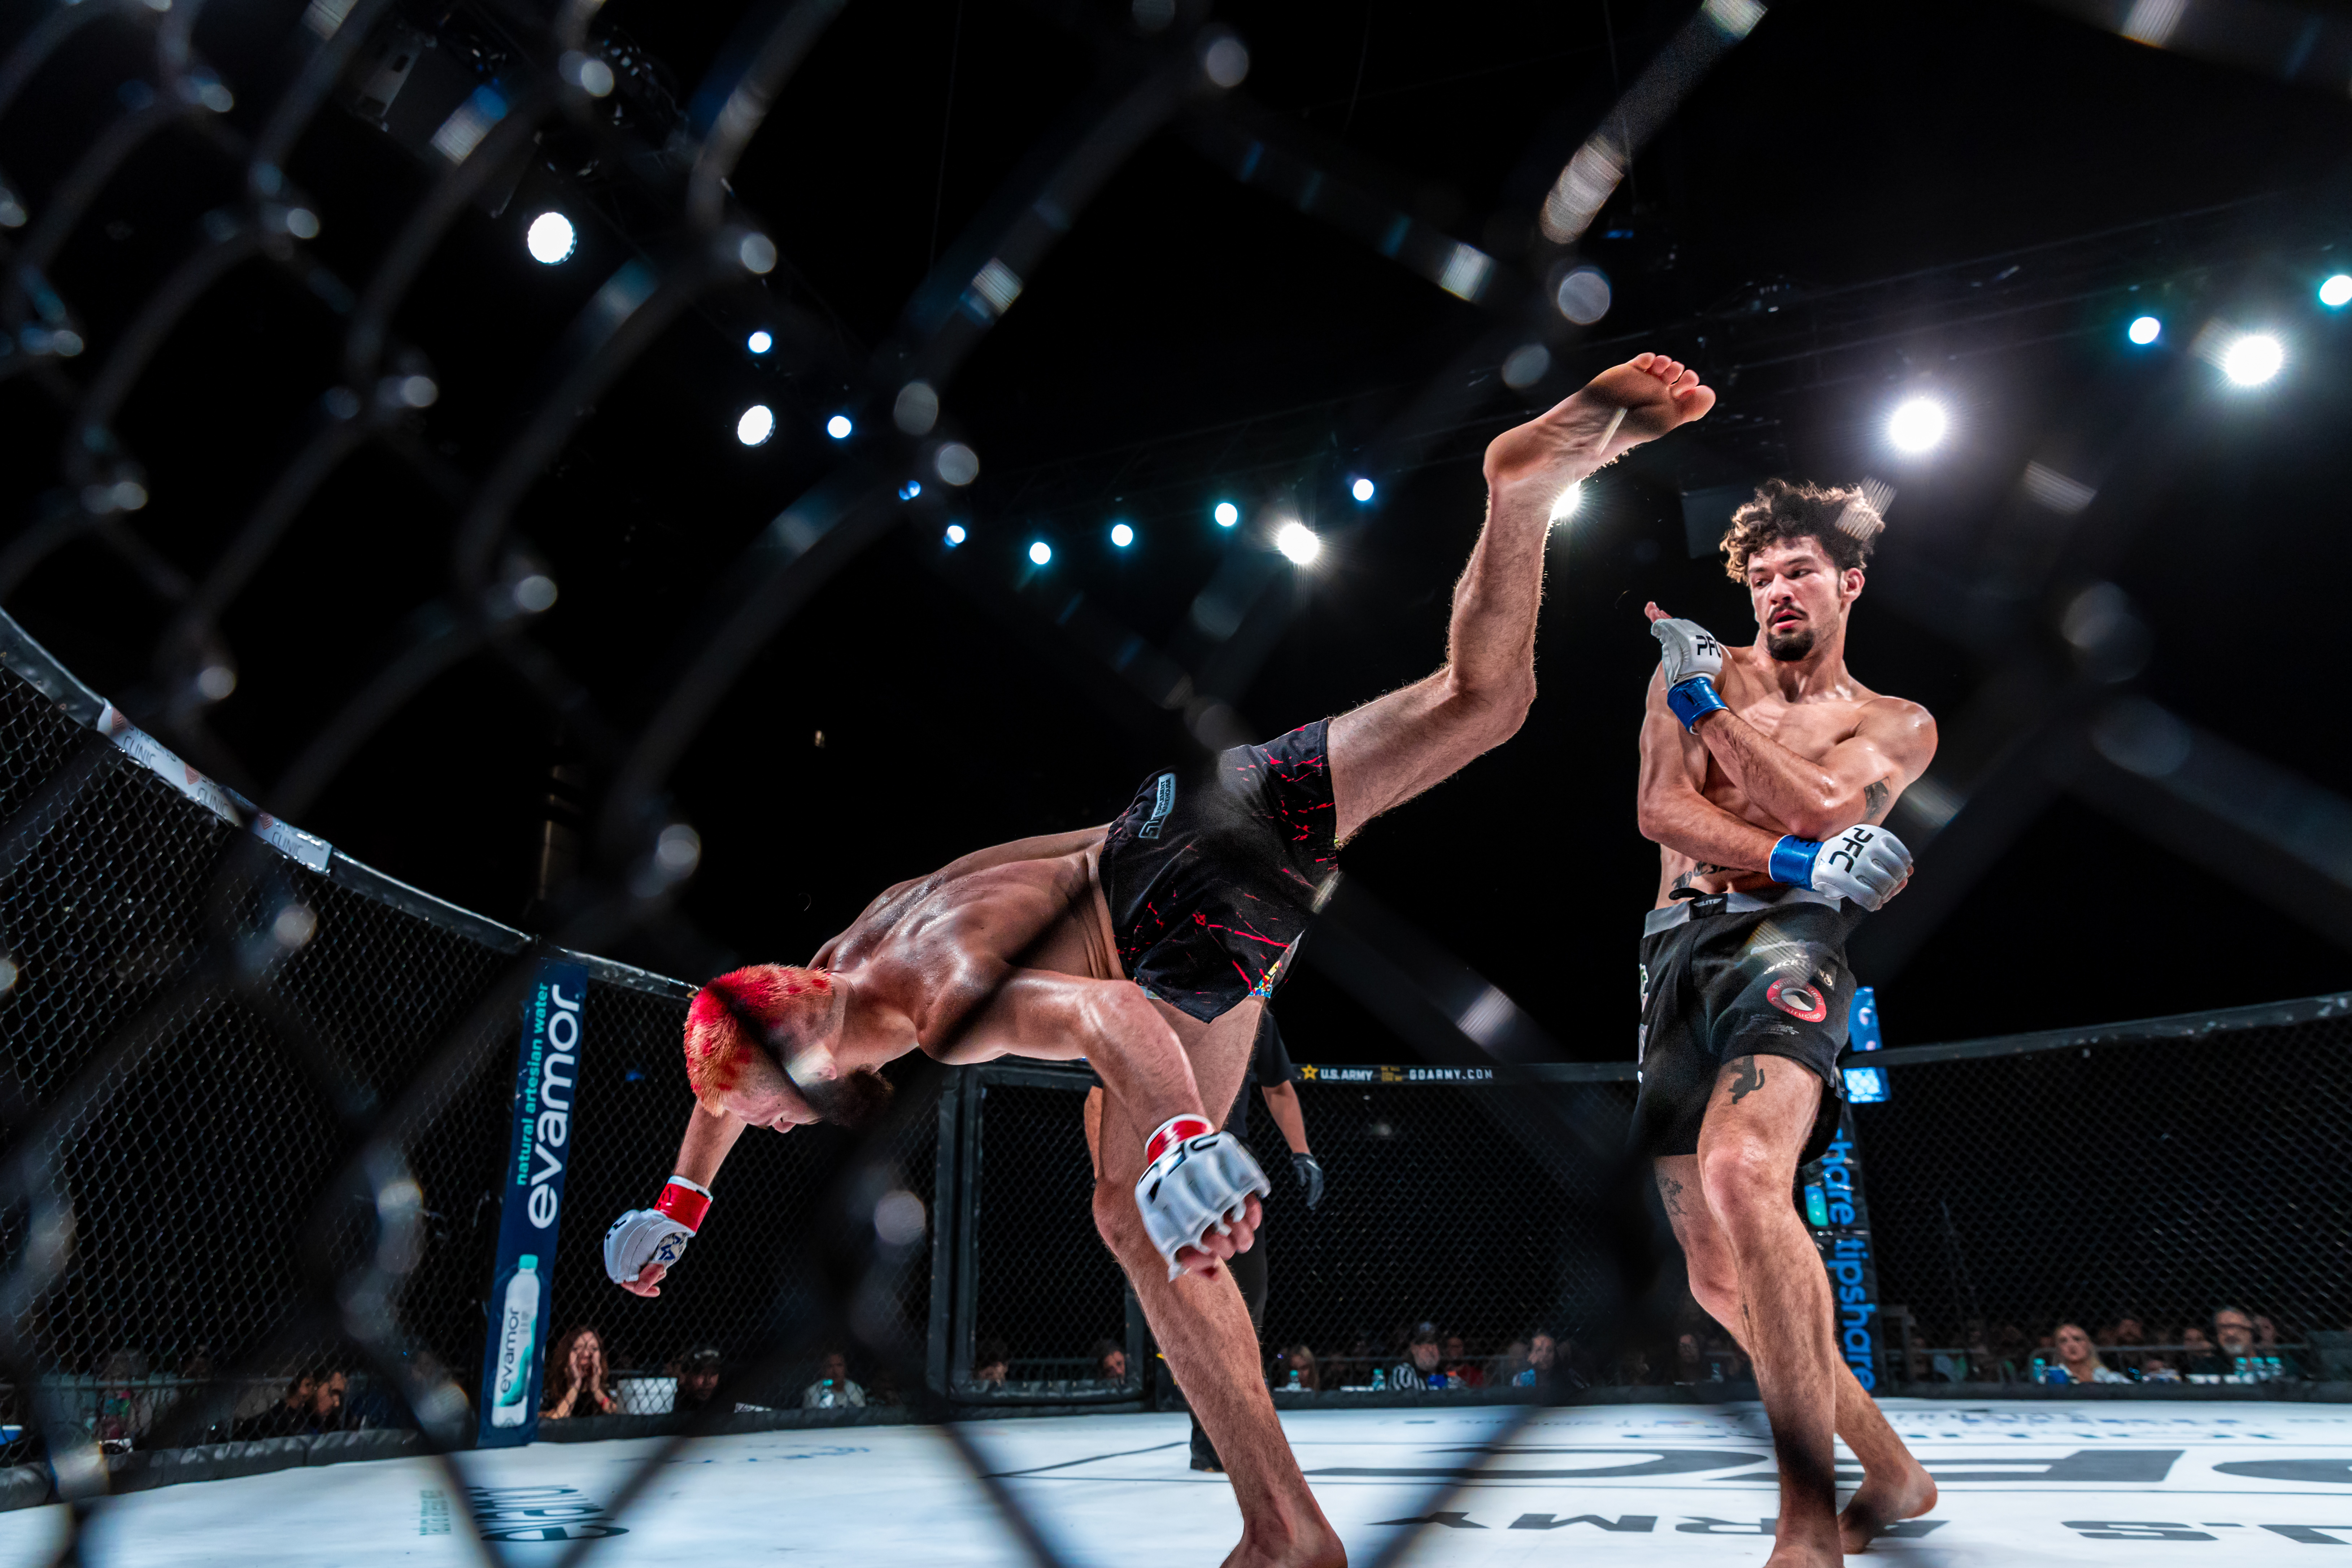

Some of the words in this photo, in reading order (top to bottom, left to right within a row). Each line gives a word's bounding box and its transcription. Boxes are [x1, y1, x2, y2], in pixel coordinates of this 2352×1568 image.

[1829, 827, 1874, 873] PFC
[534, 982, 548, 1033] water
[524, 1038, 543, 1114] artesian
[528, 984, 579, 1229] evamor
[1341, 1068, 1373, 1081] ARMY
[1409, 1068, 1493, 1080] GOARMY.COM
[517, 1118, 534, 1186] natural
[1828, 1237, 1876, 1391] tipshare
[500, 1307, 519, 1393] evamor
